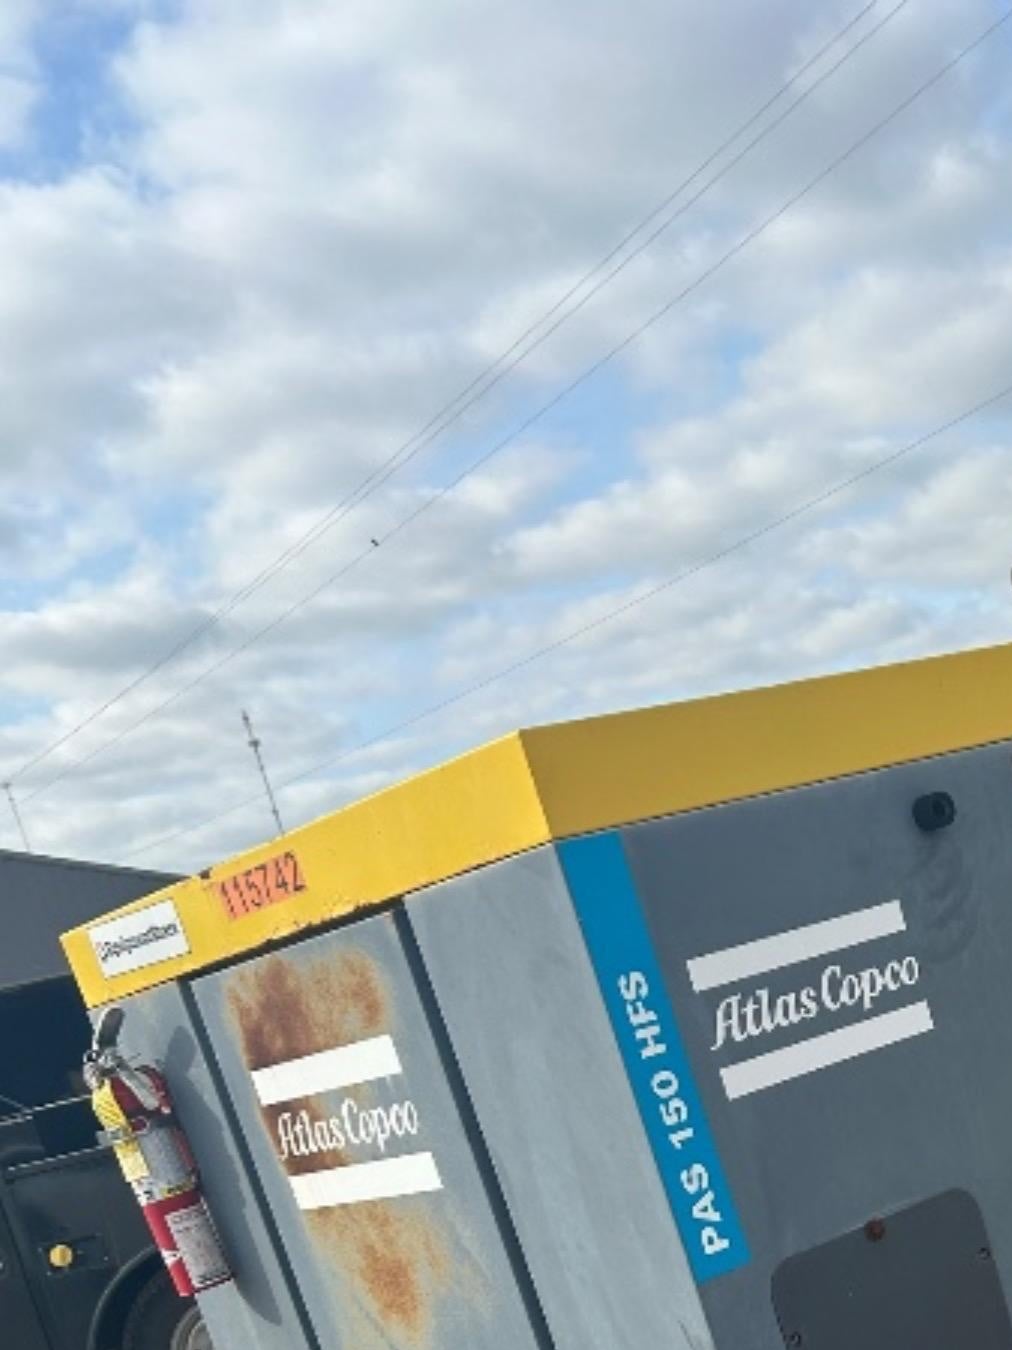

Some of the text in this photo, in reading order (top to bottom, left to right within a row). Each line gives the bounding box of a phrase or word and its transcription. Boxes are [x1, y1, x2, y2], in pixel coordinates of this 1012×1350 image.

[219, 851, 307, 919] 115742
[711, 955, 920, 1050] Atlas Copco
[277, 1097, 419, 1160] Atlas Copco
[617, 970, 731, 1255] PAS 150 HFS
